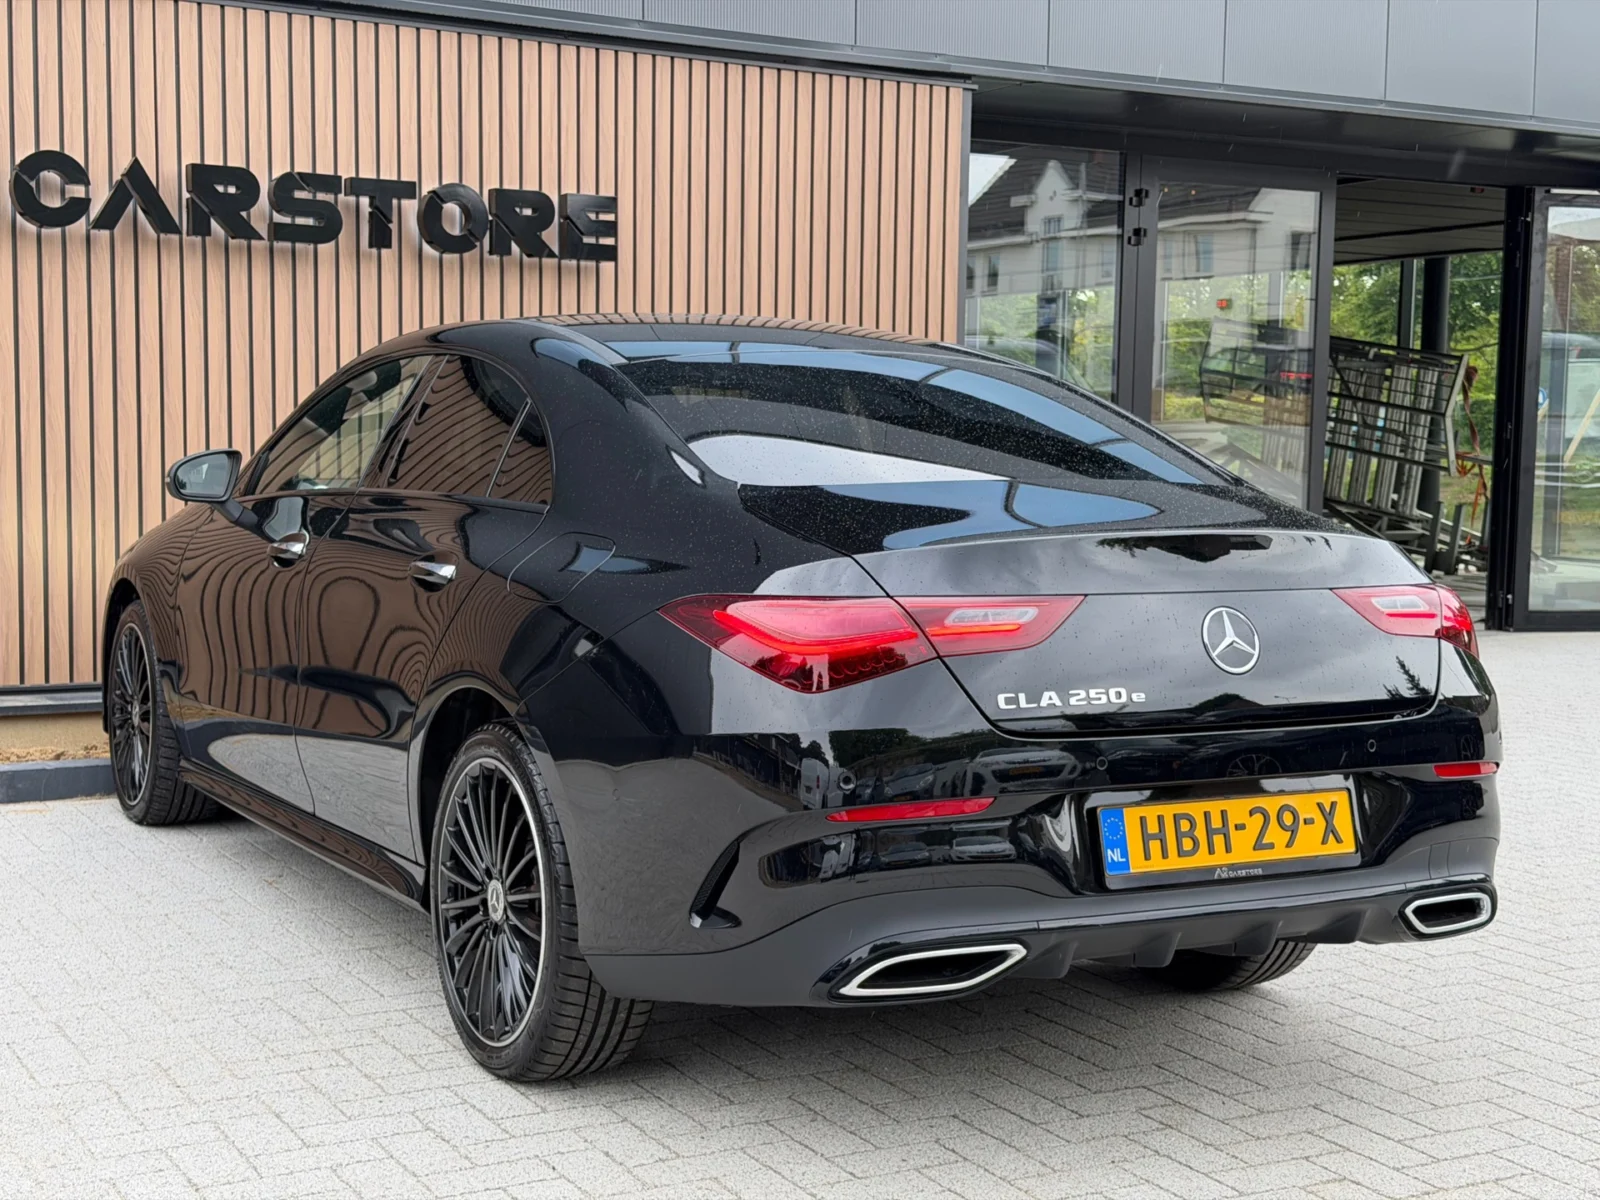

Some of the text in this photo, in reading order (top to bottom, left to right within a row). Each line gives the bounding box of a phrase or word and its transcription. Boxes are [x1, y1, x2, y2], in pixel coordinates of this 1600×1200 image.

[9, 149, 617, 262] CARSTORE
[997, 691, 1063, 710] CLA
[1139, 801, 1344, 861] HBH-29-X
[1107, 848, 1126, 863] NL
